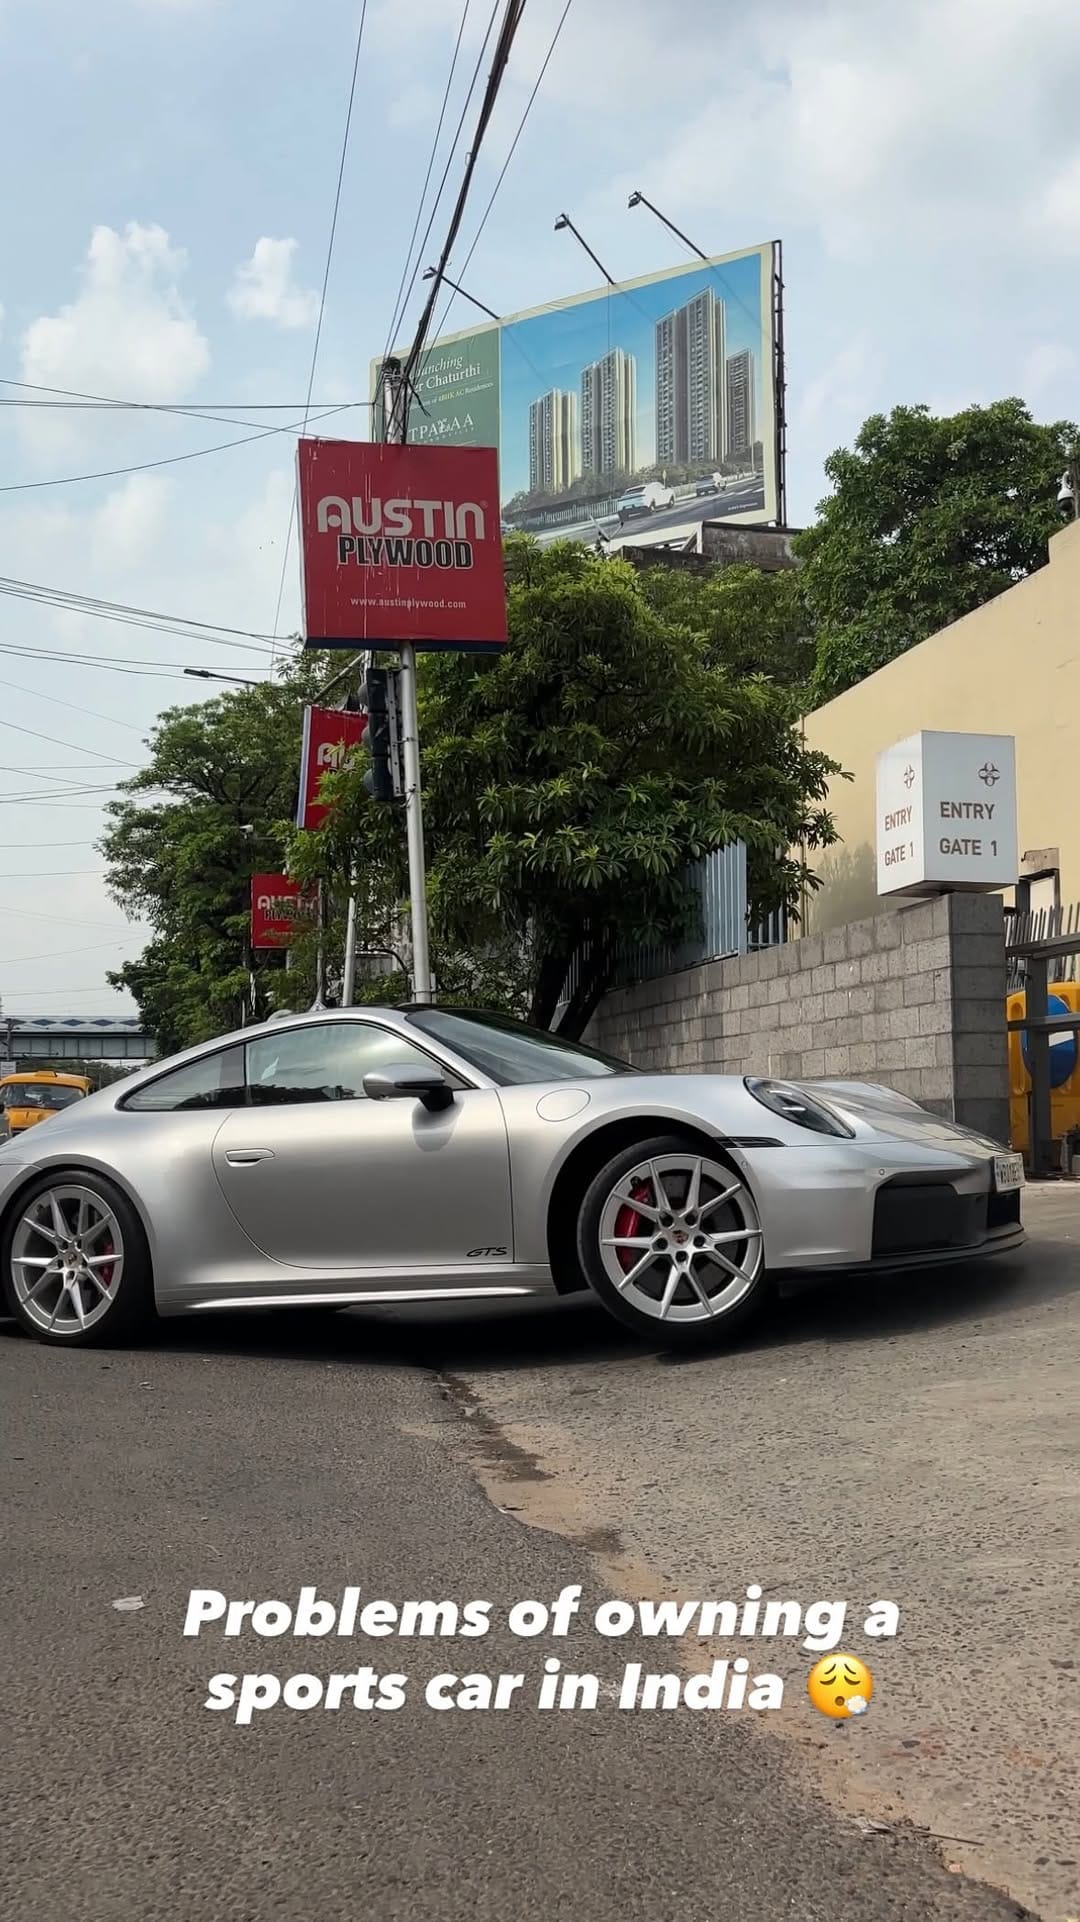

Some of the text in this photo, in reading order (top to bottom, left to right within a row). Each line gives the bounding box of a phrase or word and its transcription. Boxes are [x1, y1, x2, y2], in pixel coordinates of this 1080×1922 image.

[426, 362, 481, 389] Chaturthi
[317, 495, 486, 540] AUSTIN
[337, 535, 474, 570] PLYWOOD
[350, 597, 467, 611] www.austinplywood.com
[885, 805, 913, 831] ENTRY
[940, 801, 995, 820] ENTRY
[884, 841, 914, 867] GATE 1
[940, 837, 997, 856] GATE 1
[466, 1246, 507, 1258] GTS
